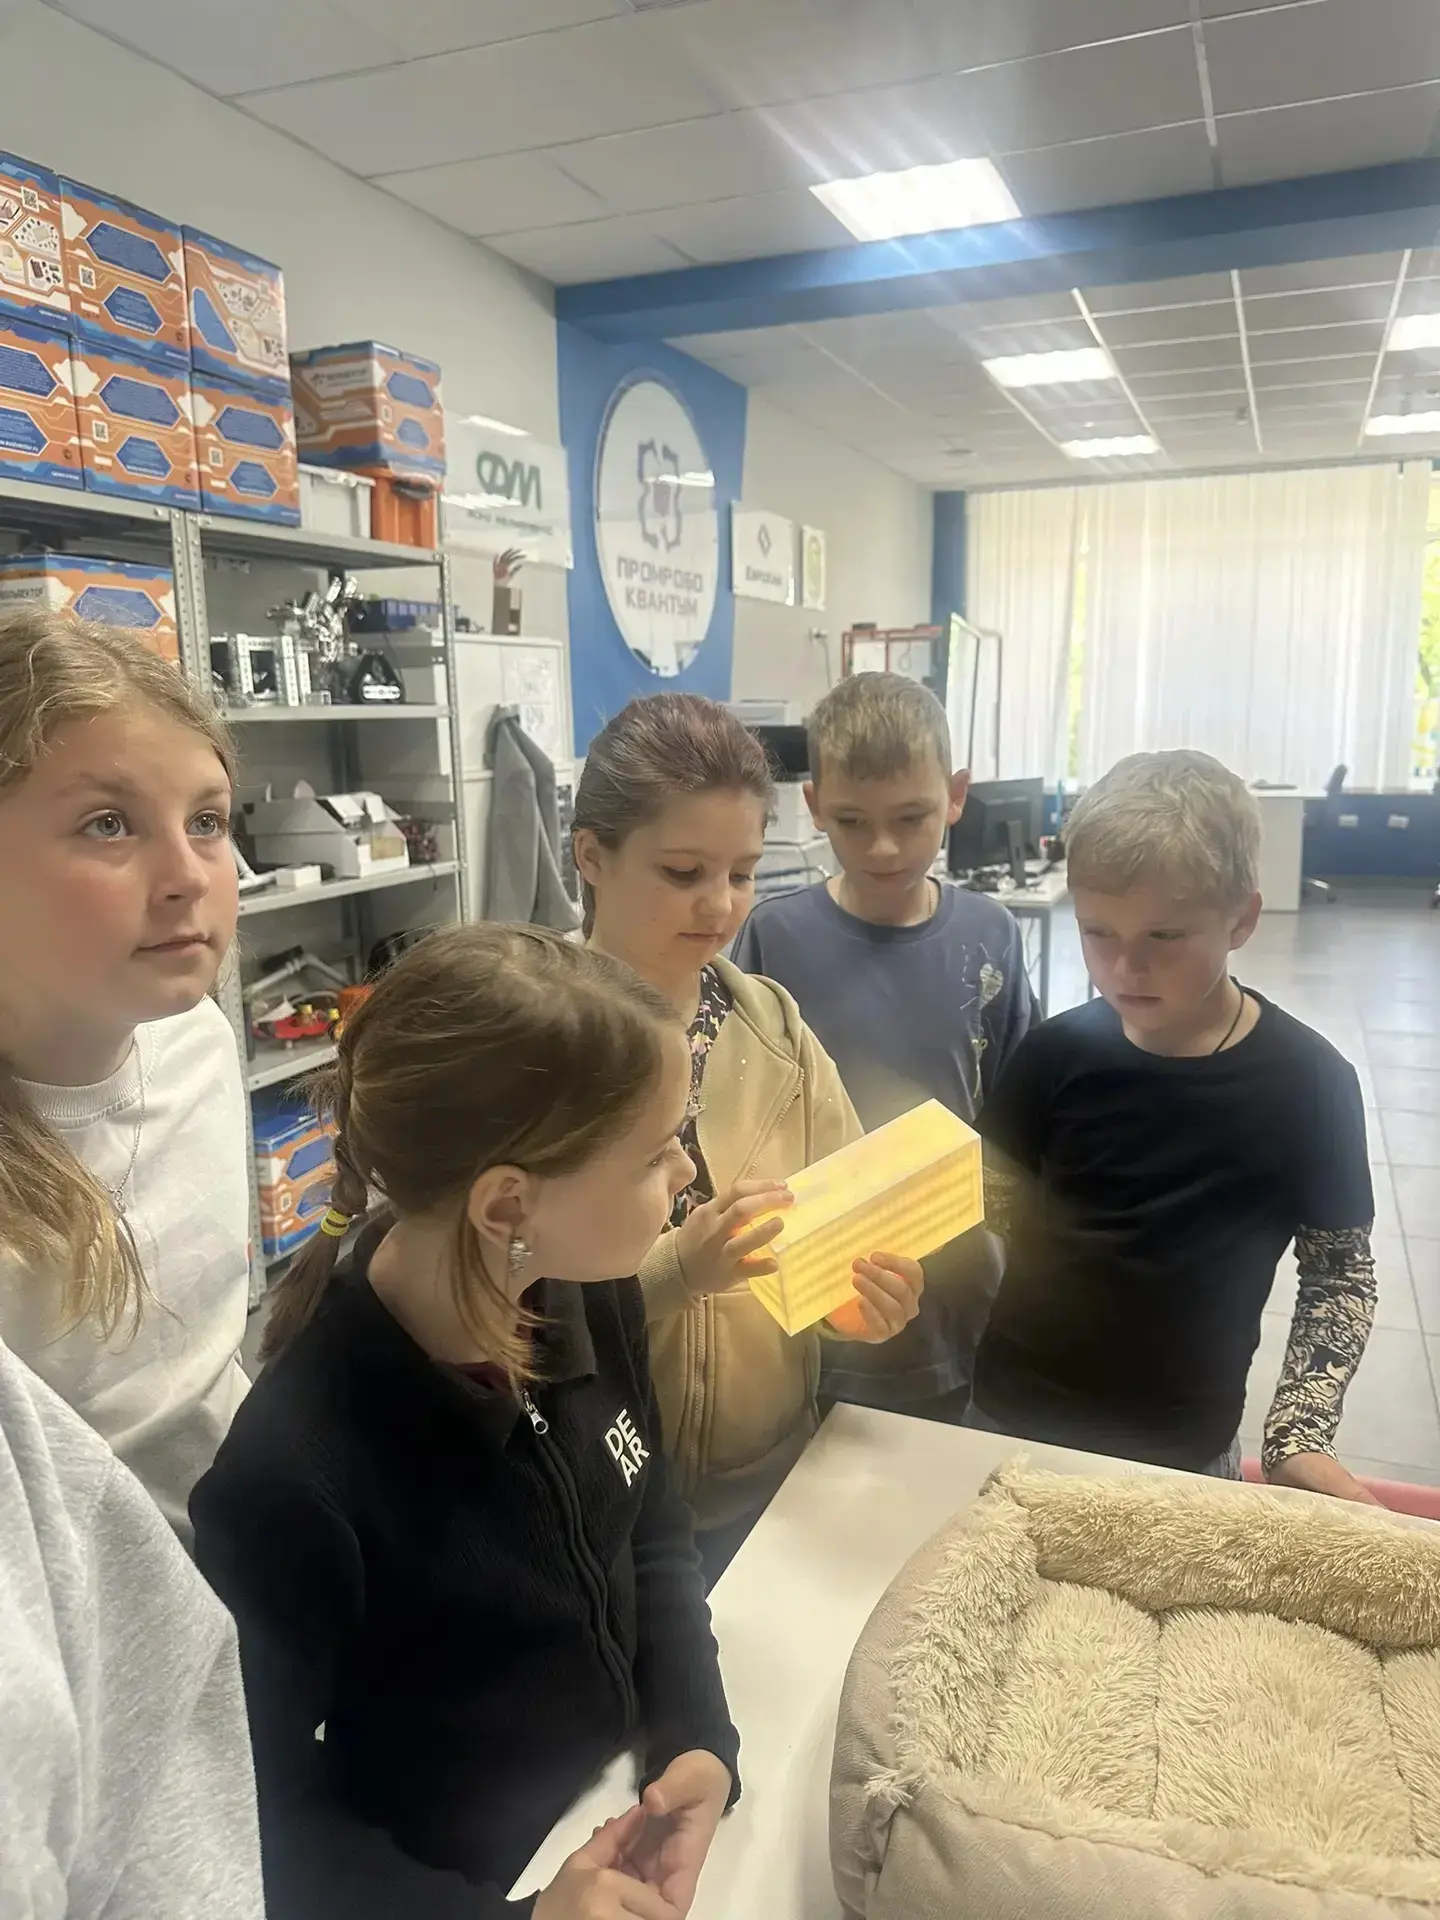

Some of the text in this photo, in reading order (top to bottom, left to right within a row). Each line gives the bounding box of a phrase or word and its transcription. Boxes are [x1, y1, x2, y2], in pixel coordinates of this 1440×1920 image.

[617, 556, 703, 593] ПРОМРОБО
[625, 586, 698, 618] КВАНТУМ
[605, 1408, 637, 1461] DE
[619, 1436, 650, 1488] AR
